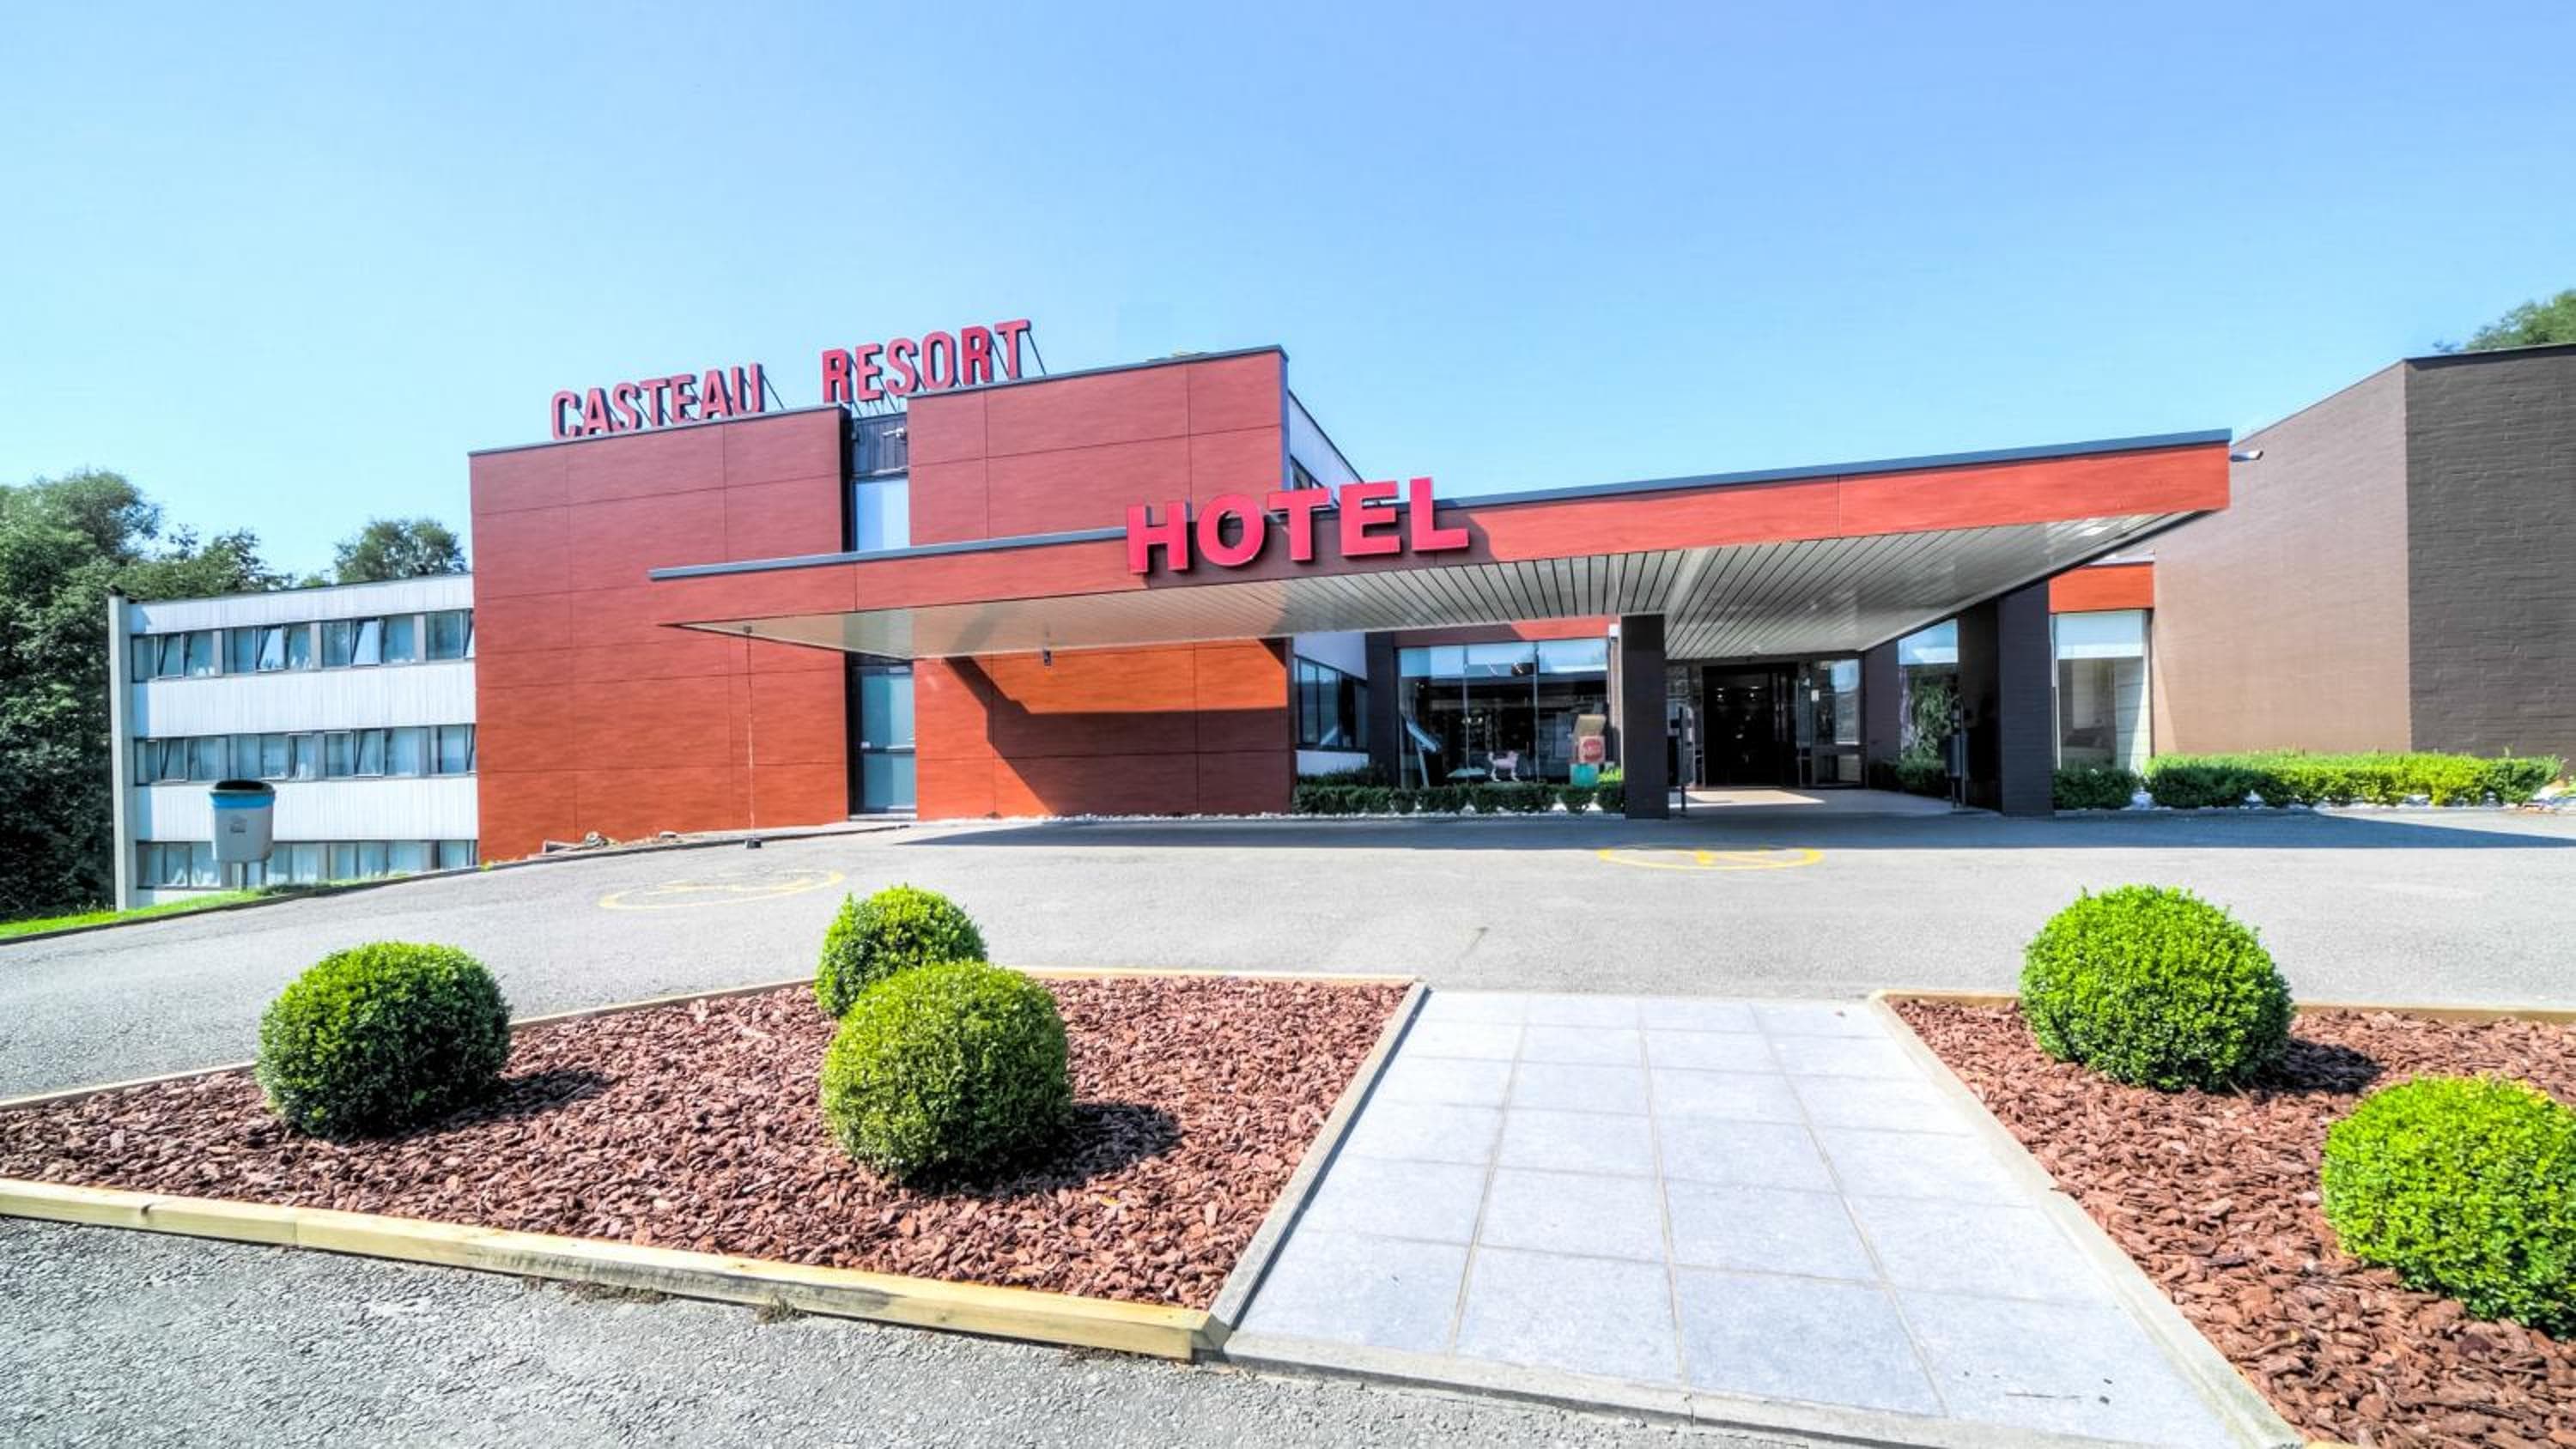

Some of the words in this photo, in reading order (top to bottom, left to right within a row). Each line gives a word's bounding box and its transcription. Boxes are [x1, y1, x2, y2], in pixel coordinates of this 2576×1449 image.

[551, 362, 766, 440] CASTEAU
[822, 318, 1030, 403] RESORT
[1127, 476, 1470, 574] HOTEL
